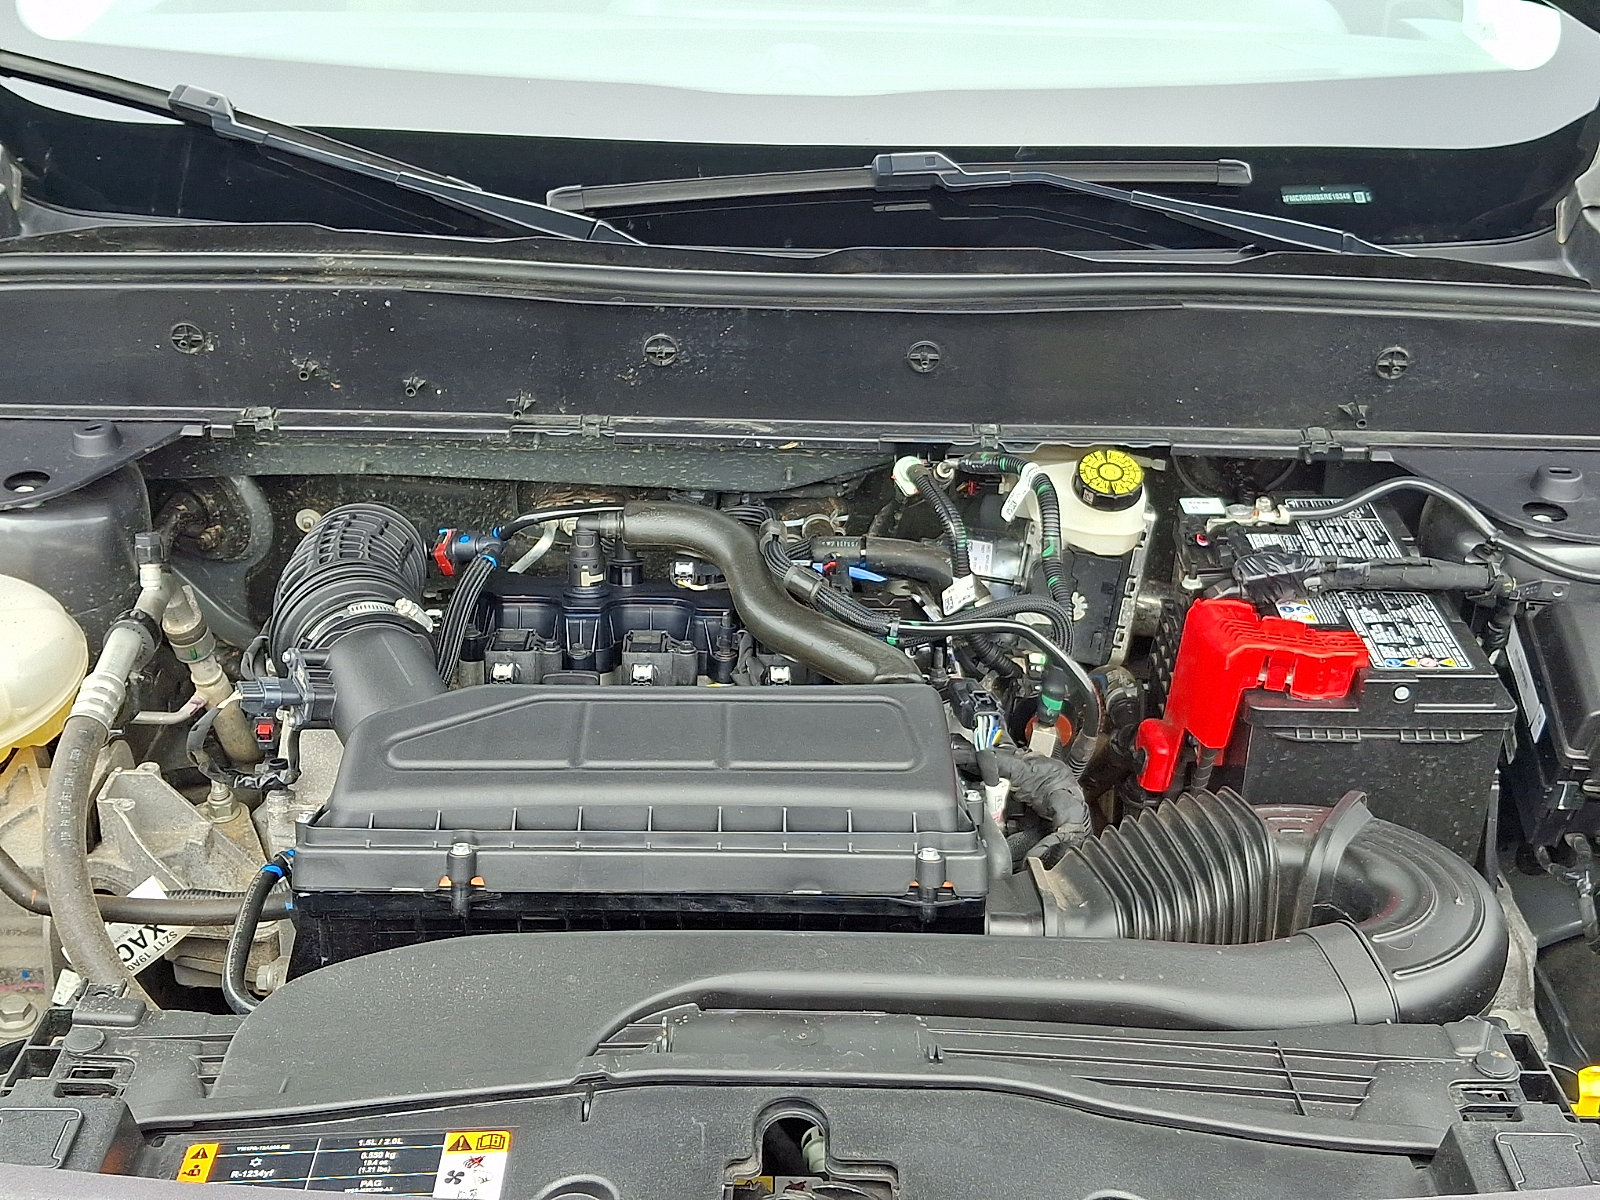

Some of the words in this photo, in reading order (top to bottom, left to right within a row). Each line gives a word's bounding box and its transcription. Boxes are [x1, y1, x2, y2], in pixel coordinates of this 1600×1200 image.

[385, 1151, 397, 1160] kg
[230, 1168, 275, 1179] R-1234yf
[359, 1179, 383, 1188] PAG
